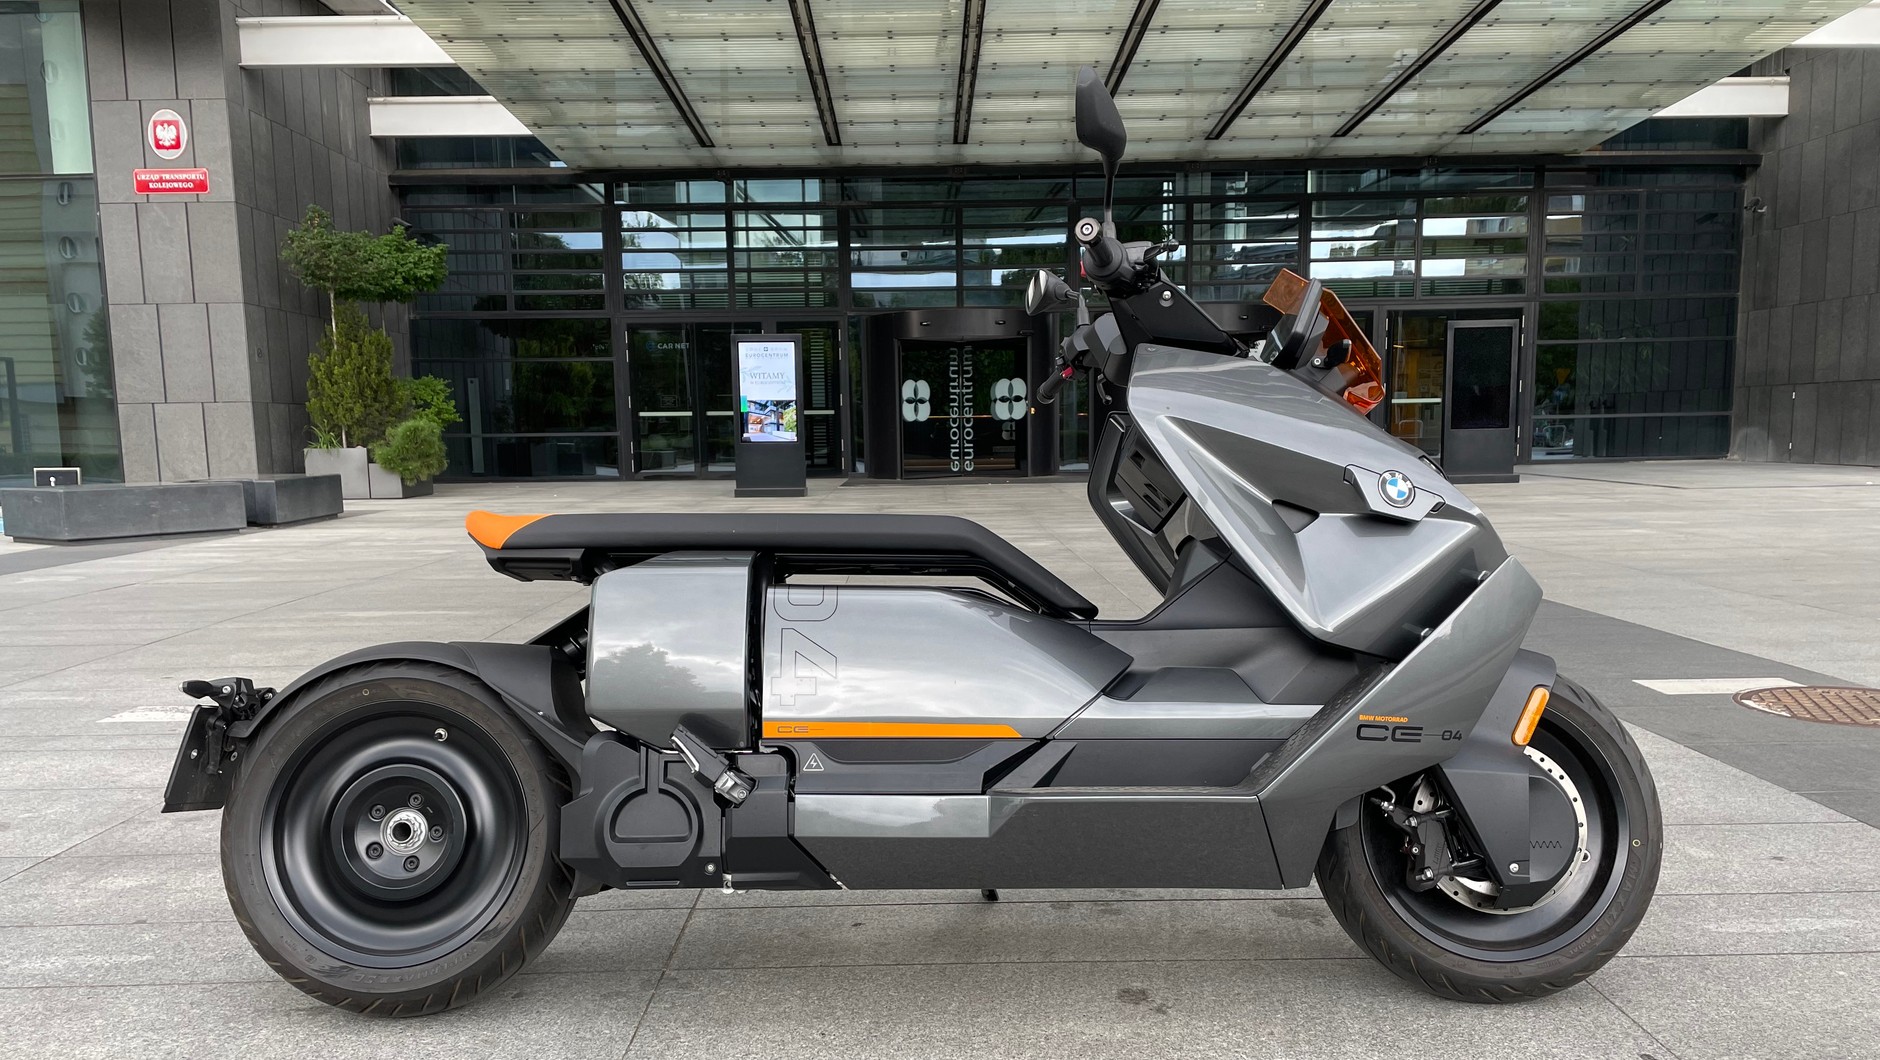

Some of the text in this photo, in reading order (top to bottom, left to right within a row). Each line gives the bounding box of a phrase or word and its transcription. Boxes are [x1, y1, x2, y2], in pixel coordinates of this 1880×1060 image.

[657, 342, 690, 350] CAR NET
[749, 372, 785, 380] WITAMY
[962, 345, 974, 472] eurocentrum
[1359, 714, 1409, 723] BMW MOTORRAD
